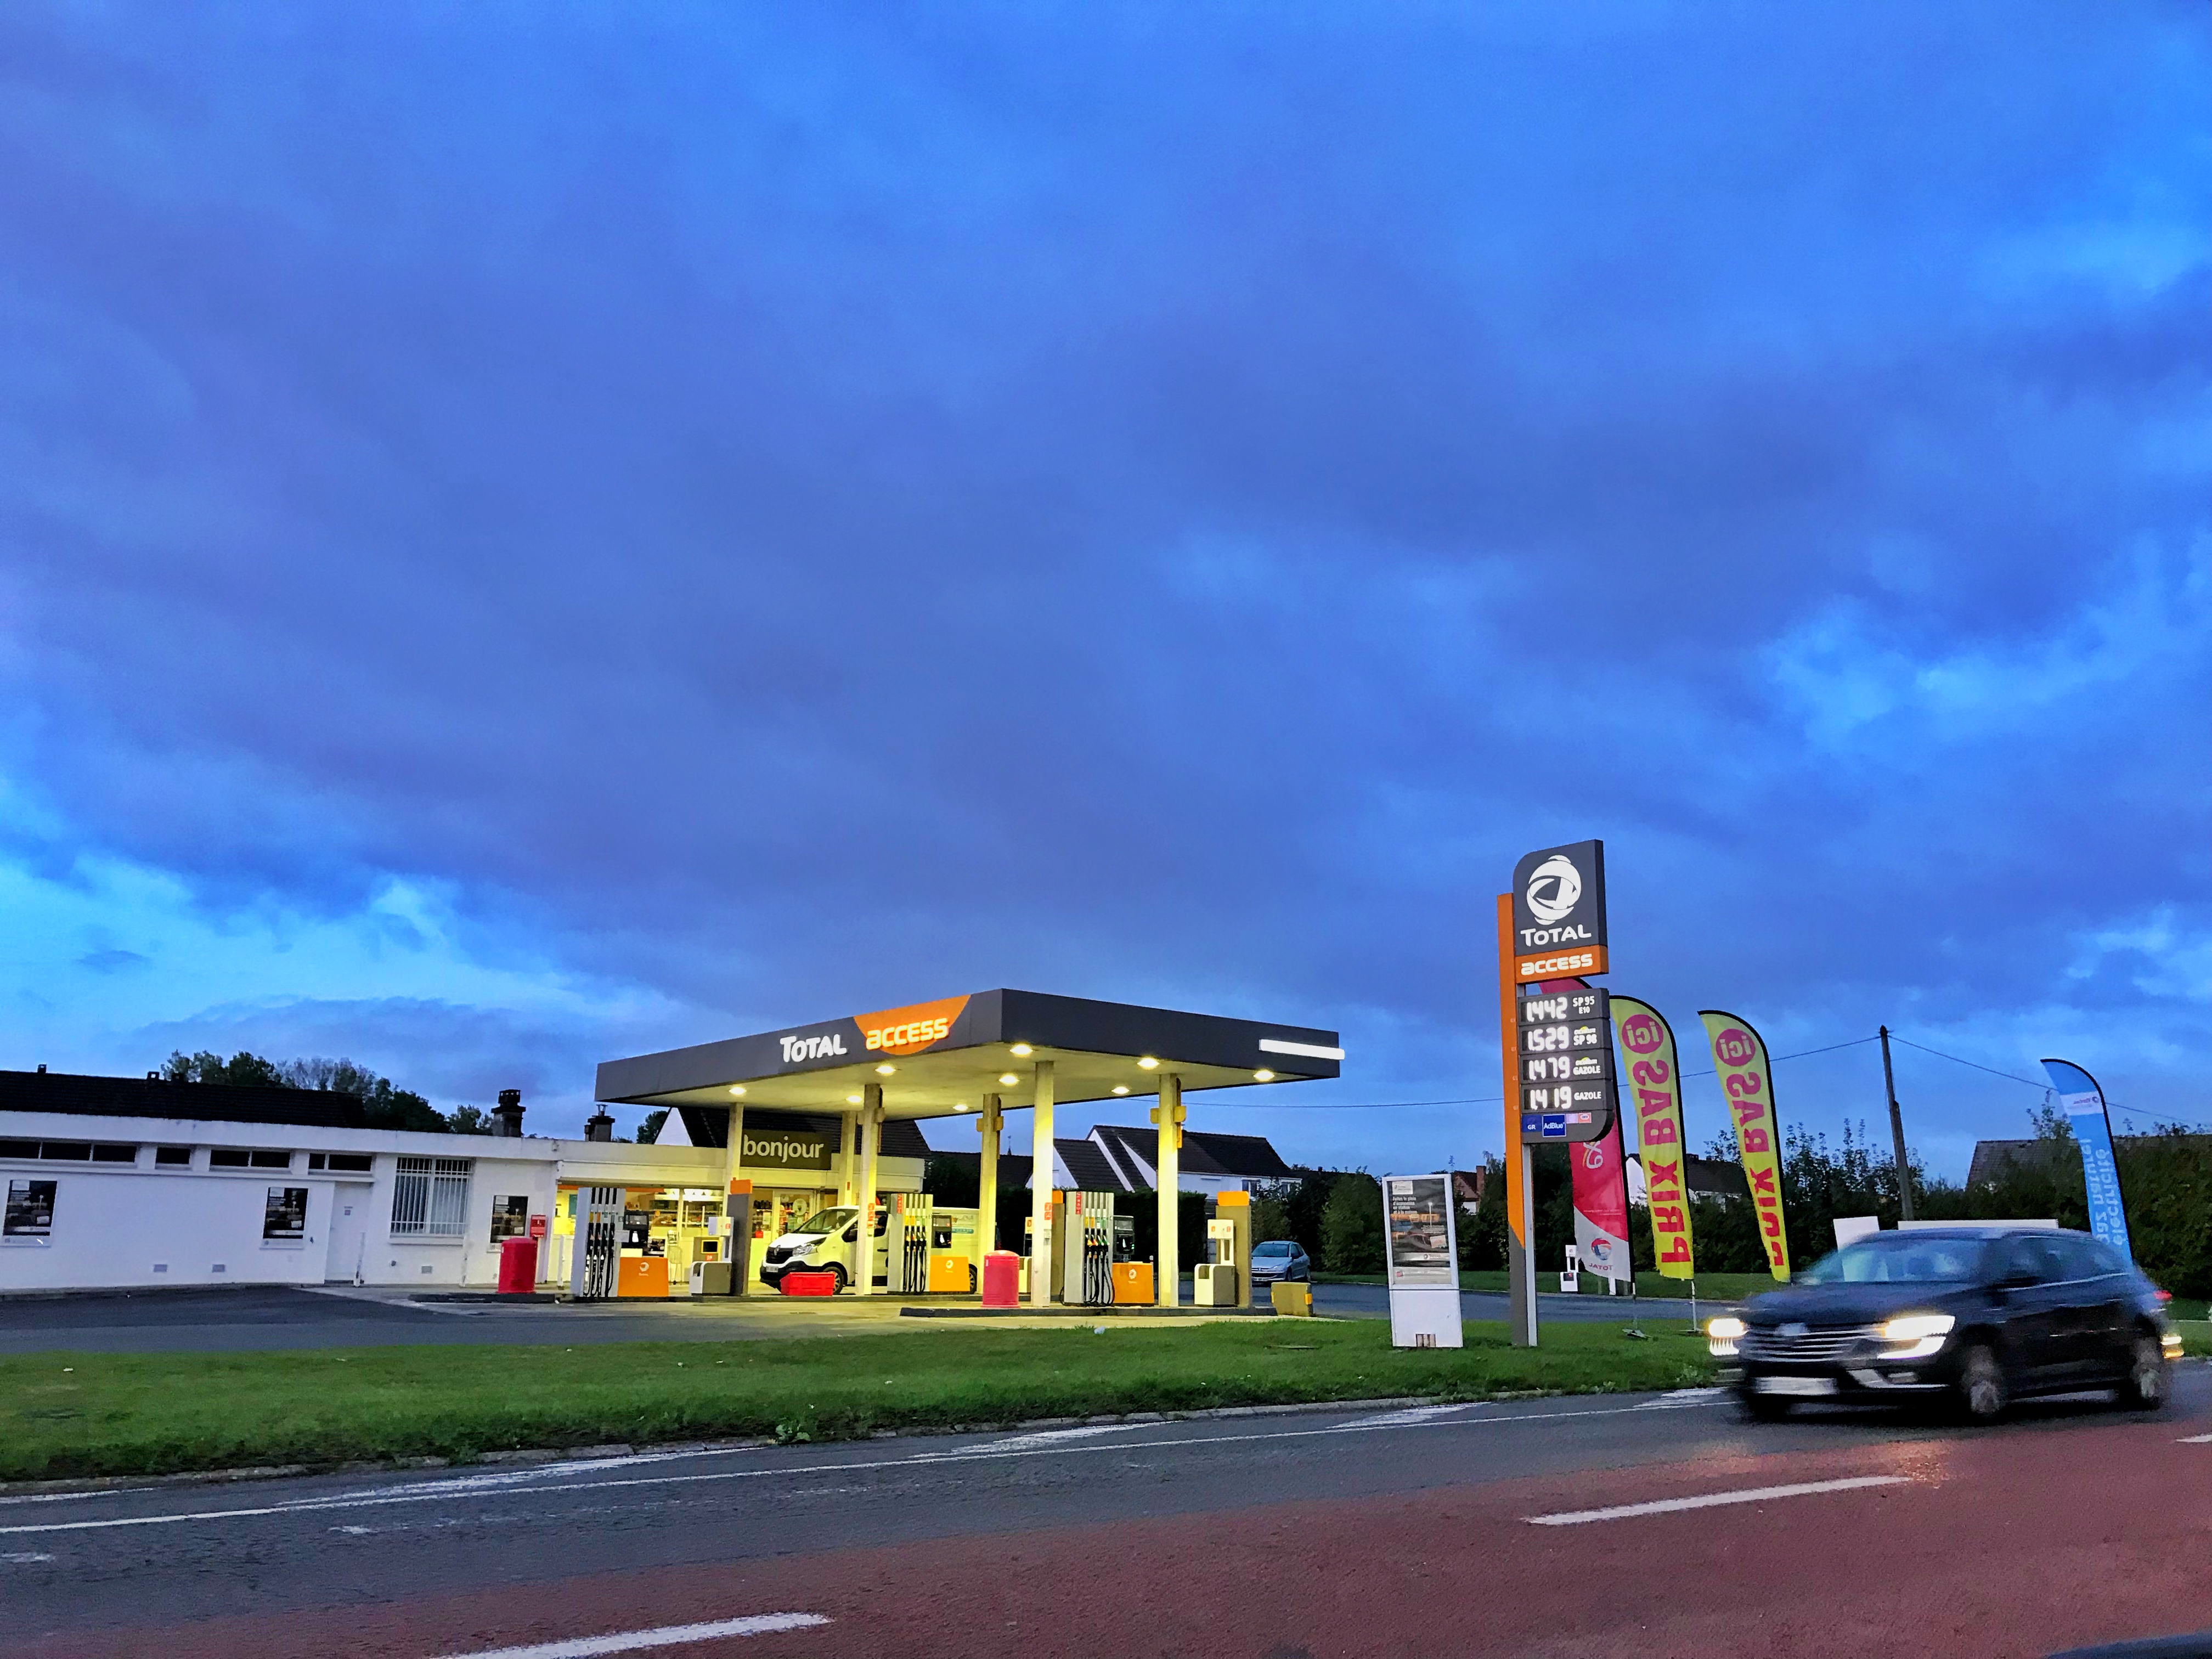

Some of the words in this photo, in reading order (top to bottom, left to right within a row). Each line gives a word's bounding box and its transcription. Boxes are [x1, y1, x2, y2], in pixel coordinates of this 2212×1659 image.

[1520, 924, 1592, 947] TOTAL
[1572, 997, 1584, 1007] SP
[1584, 996, 1595, 1005] 95
[1578, 1006, 1590, 1014] E10
[1573, 1035, 1585, 1046] SP
[1585, 1034, 1598, 1045] 98
[779, 1034, 848, 1063] TOTAL
[1573, 1065, 1601, 1075] GAZOLE
[1573, 1091, 1602, 1101] GAZOLE
[743, 1134, 825, 1163] bonjour
